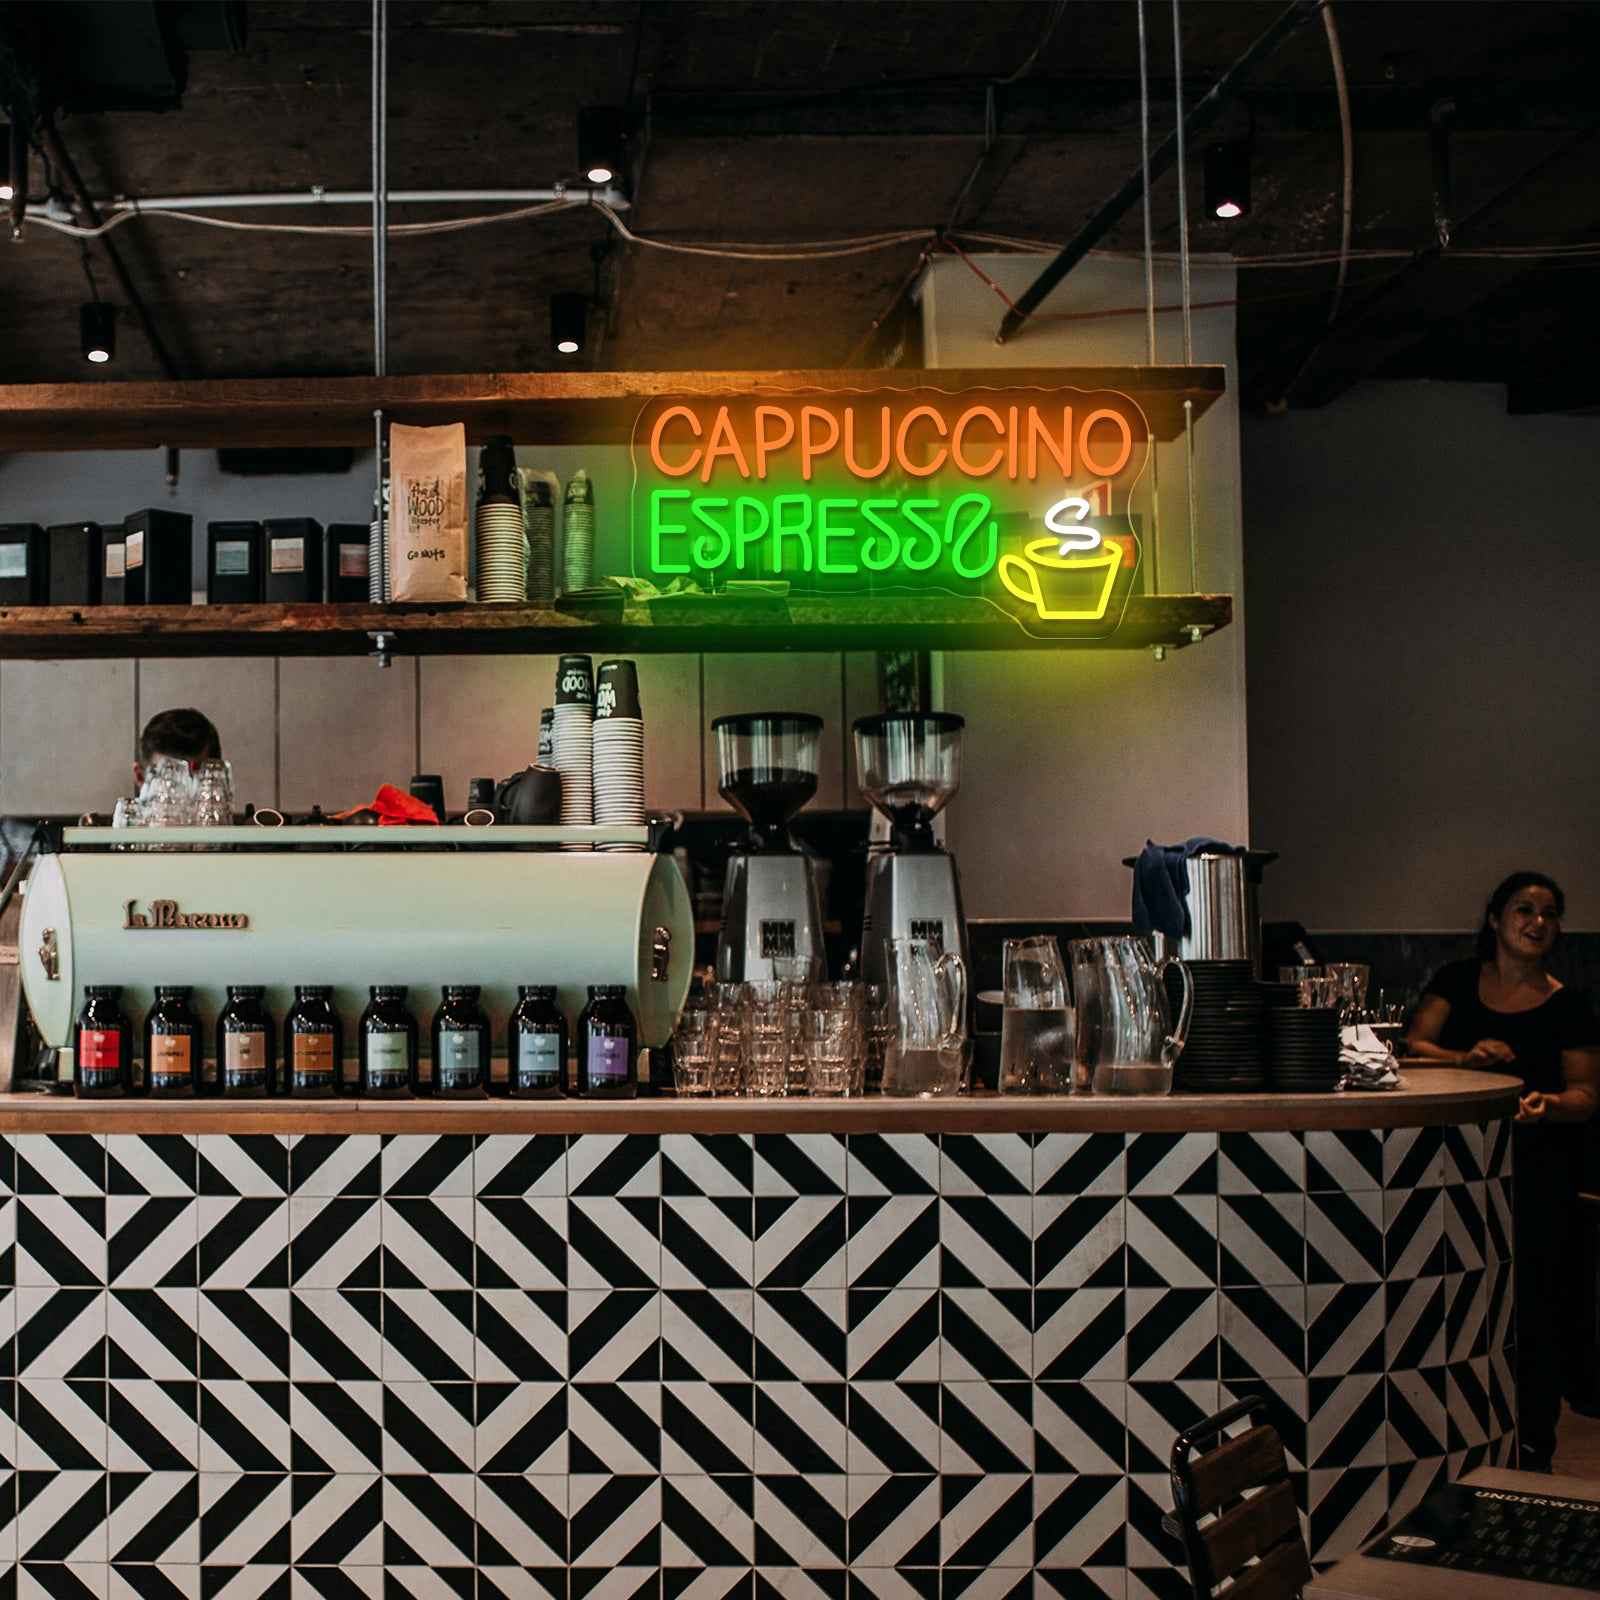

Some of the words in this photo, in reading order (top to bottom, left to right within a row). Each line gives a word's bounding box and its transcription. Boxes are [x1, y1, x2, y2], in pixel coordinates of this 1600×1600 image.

[650, 405, 1132, 482] CAPPUCCINO
[408, 496, 445, 516] WOOD
[650, 488, 998, 579] ESPRESSO
